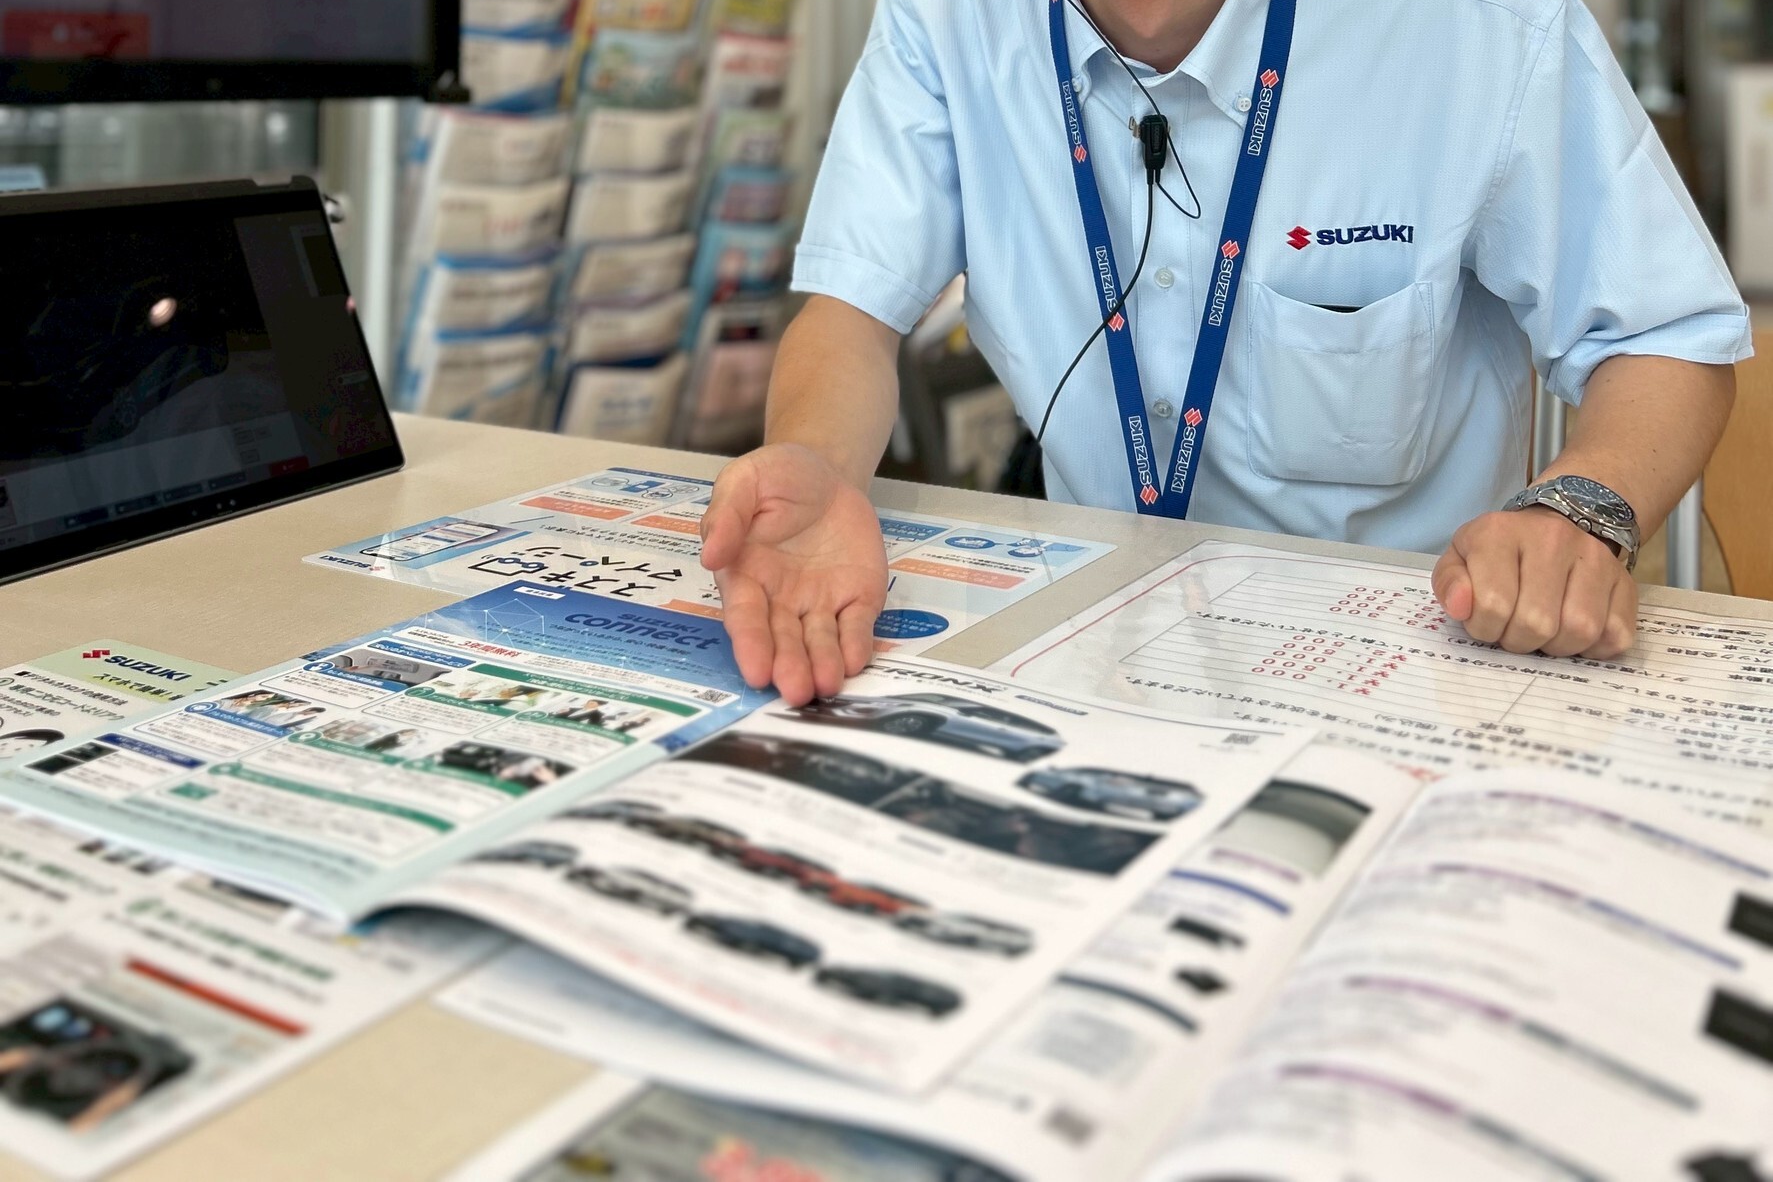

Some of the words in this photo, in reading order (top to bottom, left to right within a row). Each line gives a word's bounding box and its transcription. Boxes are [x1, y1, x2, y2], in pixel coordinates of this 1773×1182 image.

[1061, 80, 1083, 146] SUZUKI
[1247, 87, 1273, 156] SUZUKI
[1316, 224, 1414, 245] SUZUKI
[1094, 245, 1118, 313] SUZUKI
[1208, 256, 1235, 326] SUZUKI
[1128, 415, 1152, 486] SUZUKI
[1171, 424, 1200, 493] SUZUKI
[319, 554, 371, 570] SUZUKI
[511, 545, 686, 582] マイページ
[1354, 586, 1438, 606] 4,400
[564, 612, 721, 650] connect
[617, 612, 703, 634] SUZUKI
[104, 655, 193, 681] SUZUKI
[1478, 721, 1526, 736] 洗車
